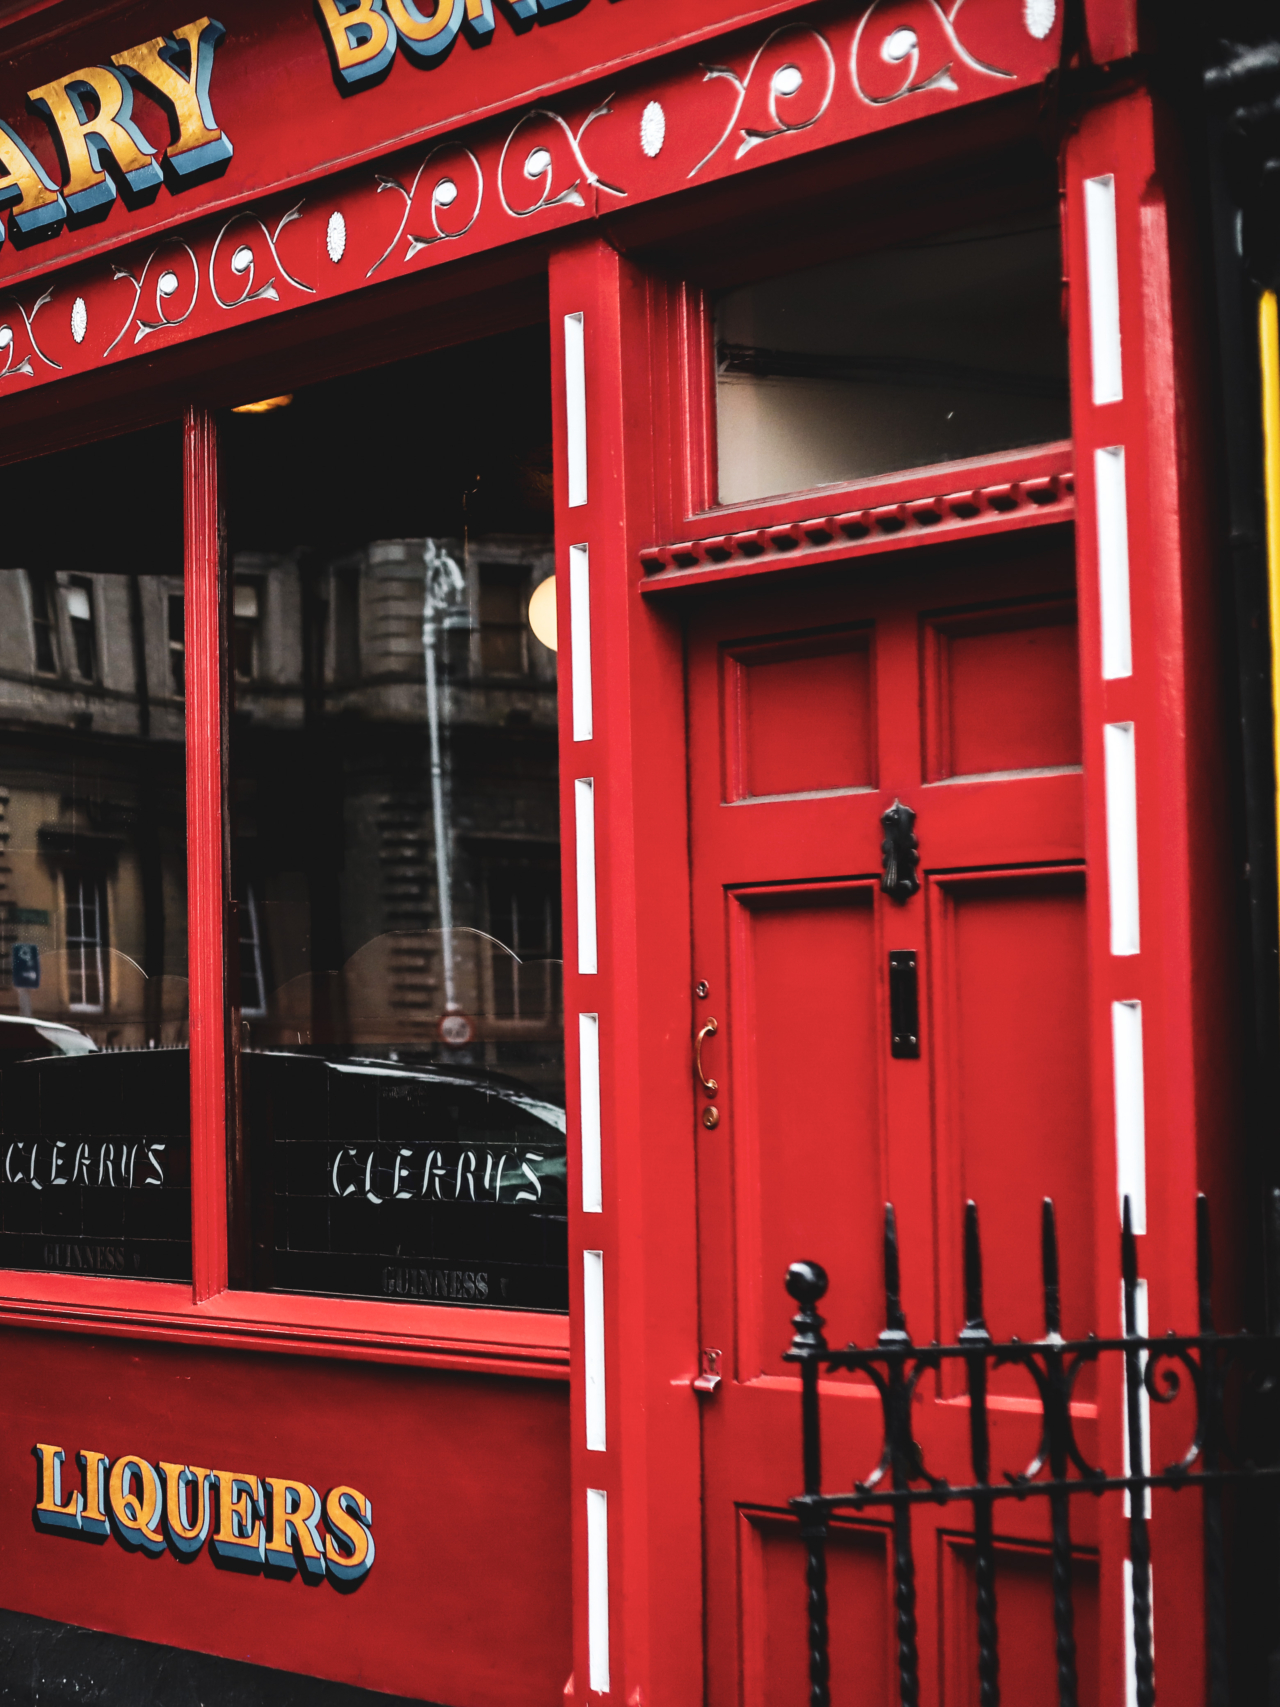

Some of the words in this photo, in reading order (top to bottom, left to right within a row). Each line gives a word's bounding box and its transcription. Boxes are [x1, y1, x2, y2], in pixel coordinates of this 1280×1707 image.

[43, 1242, 125, 1271] GUINNESS
[381, 1265, 489, 1300] GUINNESS
[35, 1442, 375, 1580] LIQUERS
